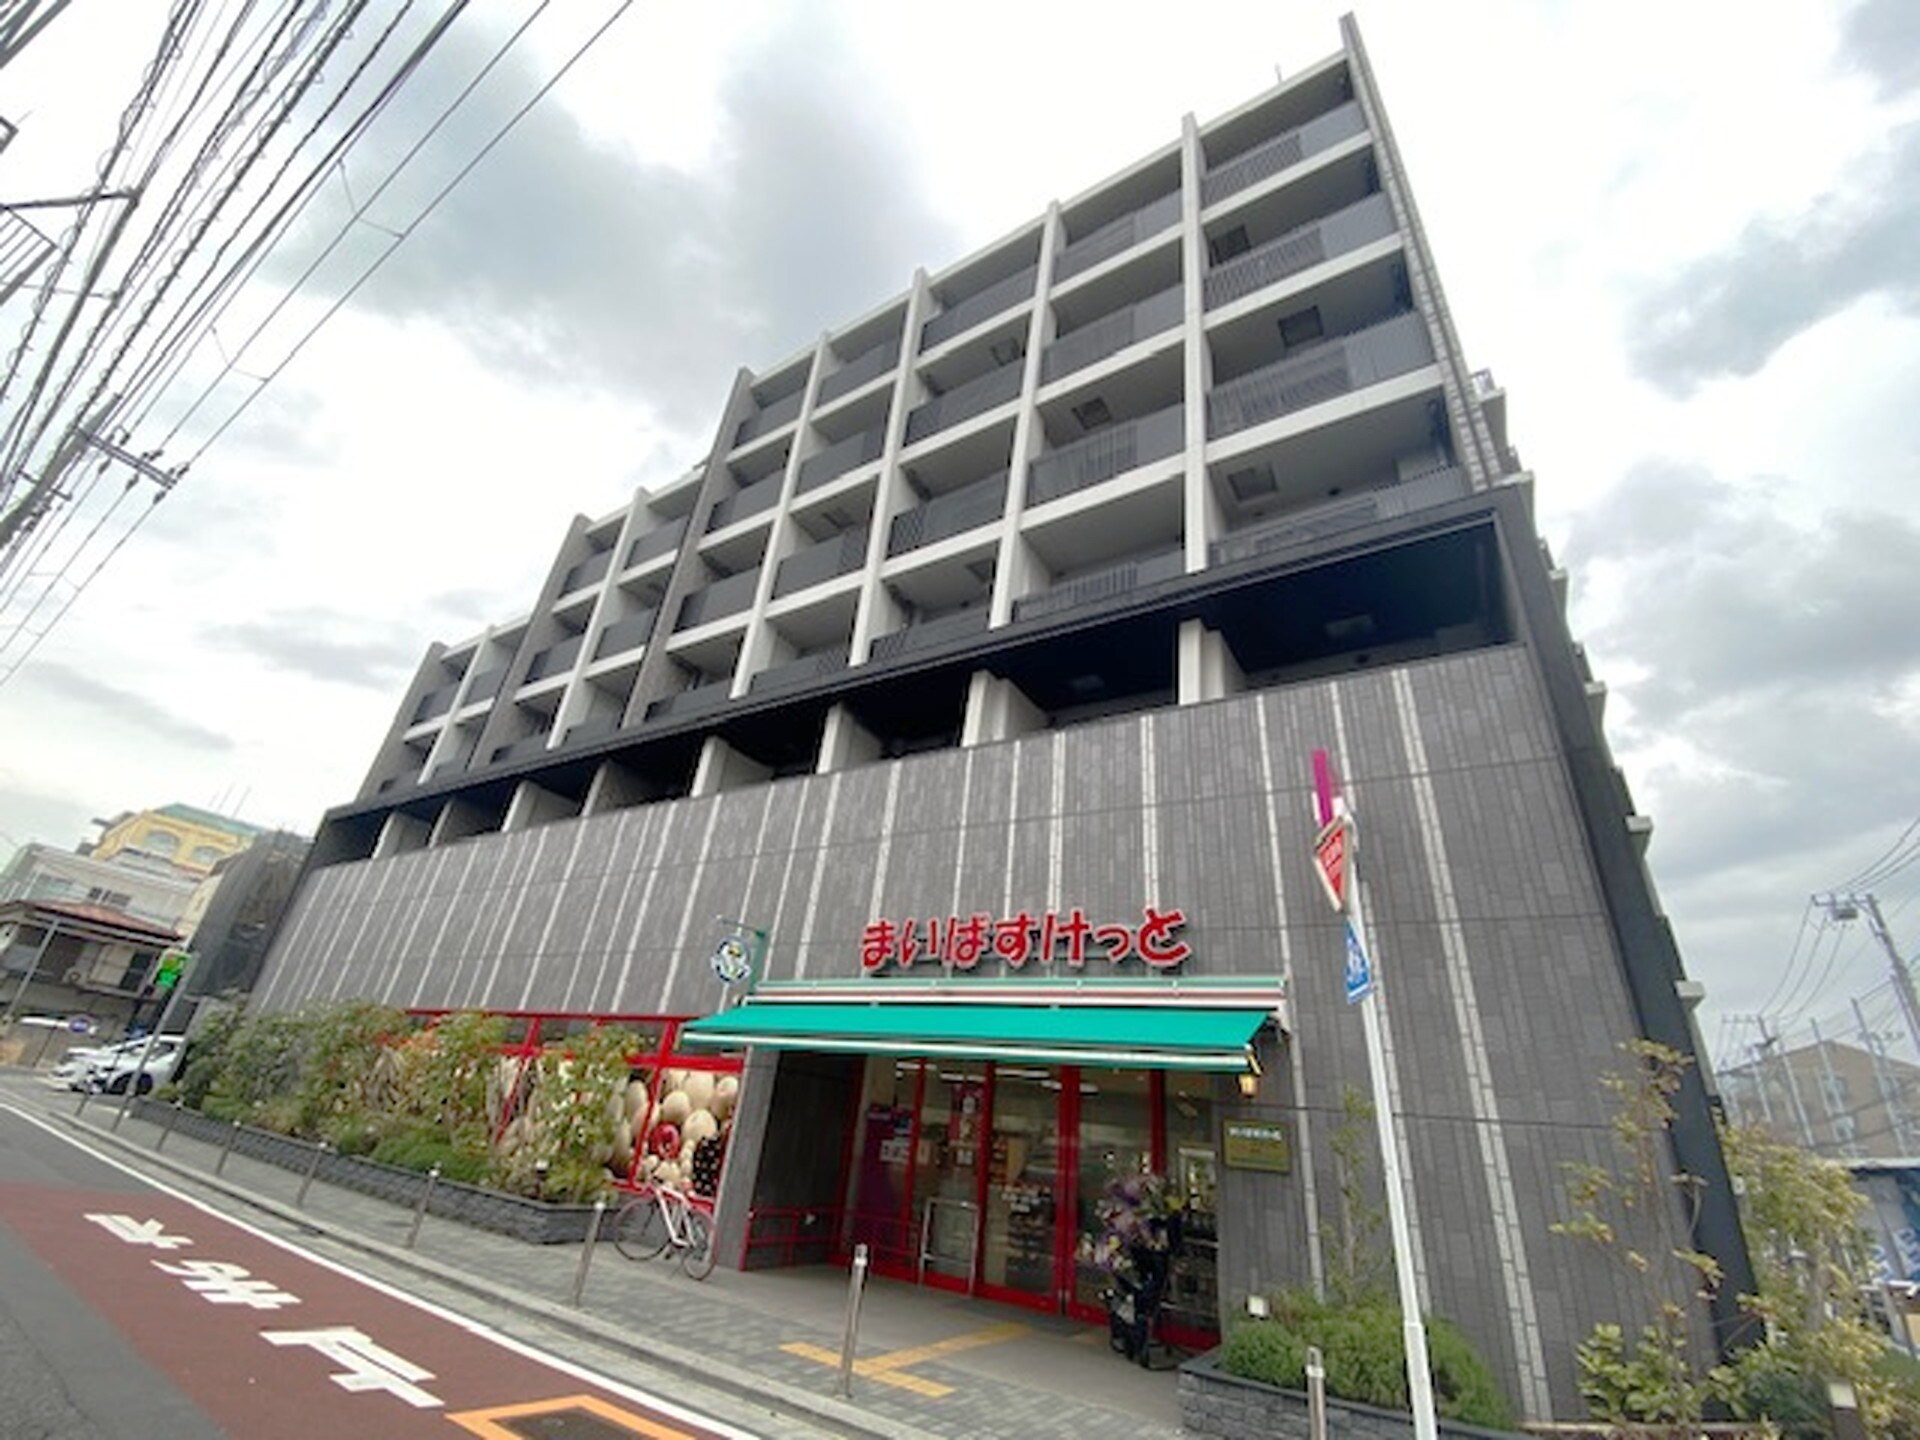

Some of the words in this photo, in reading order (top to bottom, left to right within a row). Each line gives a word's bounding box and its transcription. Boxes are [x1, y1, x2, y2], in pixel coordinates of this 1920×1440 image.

[861, 907, 1191, 968] まいばすけっと
